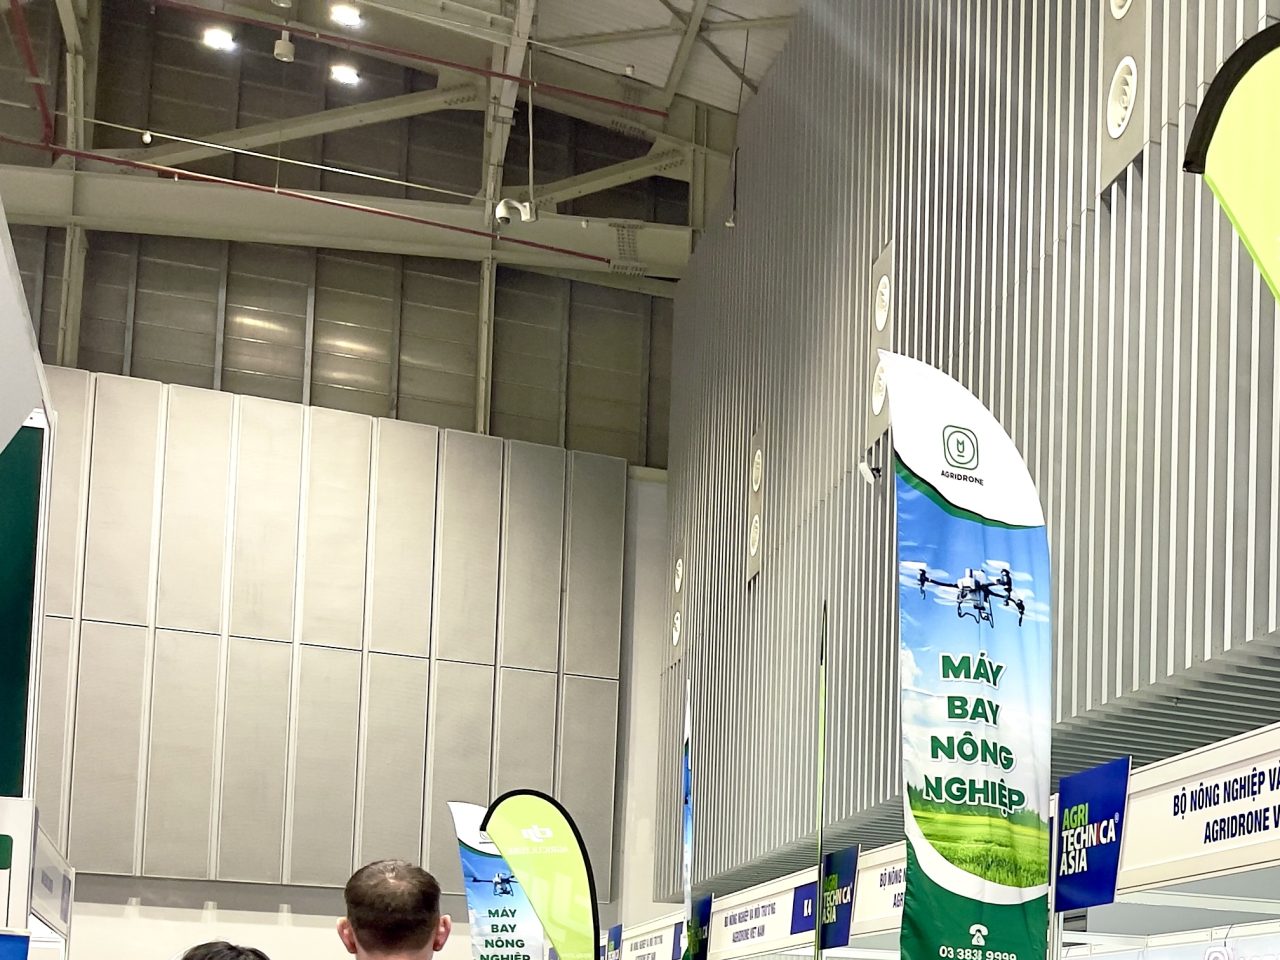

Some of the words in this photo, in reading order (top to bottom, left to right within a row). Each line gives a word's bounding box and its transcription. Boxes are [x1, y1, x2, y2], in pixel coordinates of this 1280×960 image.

[940, 469, 984, 487] AGRIDRONE
[941, 651, 1004, 687] MÁY
[946, 695, 1000, 726] BAY
[930, 731, 1014, 770] NÔNG
[923, 773, 1026, 815] NGHIỆP
[1173, 787, 1187, 820] BỘ
[1190, 782, 1220, 813] NÔNG
[1223, 766, 1265, 802] NGHIỆP
[1062, 802, 1089, 830] AGRI
[1203, 806, 1270, 845] AGRIDRONE
[1059, 848, 1088, 877] ASIA
[487, 906, 517, 918] MÁY
[484, 936, 525, 948] NÔNG
[491, 924, 517, 933] BAY
[939, 945, 955, 960] 03
